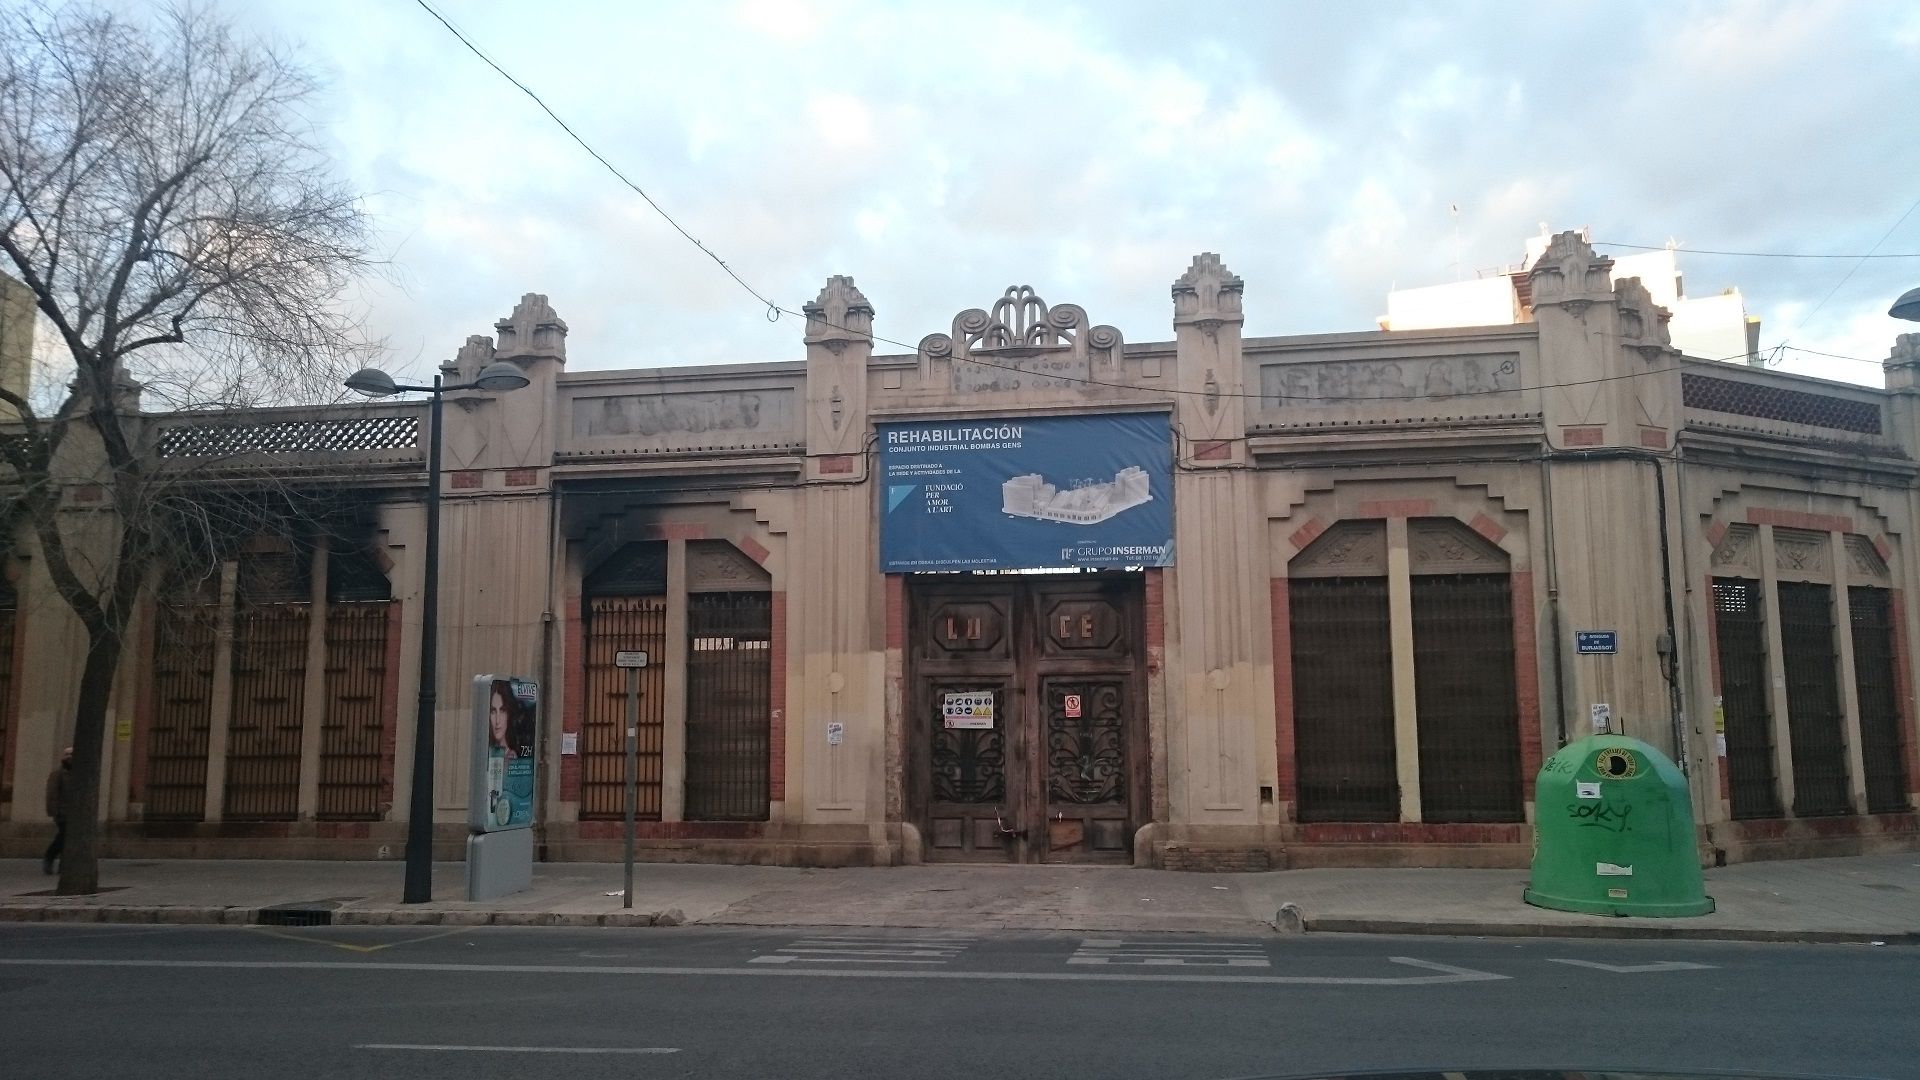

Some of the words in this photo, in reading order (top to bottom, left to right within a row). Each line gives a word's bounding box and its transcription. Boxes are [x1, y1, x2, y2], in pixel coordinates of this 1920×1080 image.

[888, 424, 1022, 443] REHABILITACIÓN
[888, 445, 926, 453] CONJUNTO
[927, 443, 969, 452] INDUSTRIAL
[970, 442, 1001, 450] BOMBAS
[925, 482, 964, 492] FUNDACIÓ
